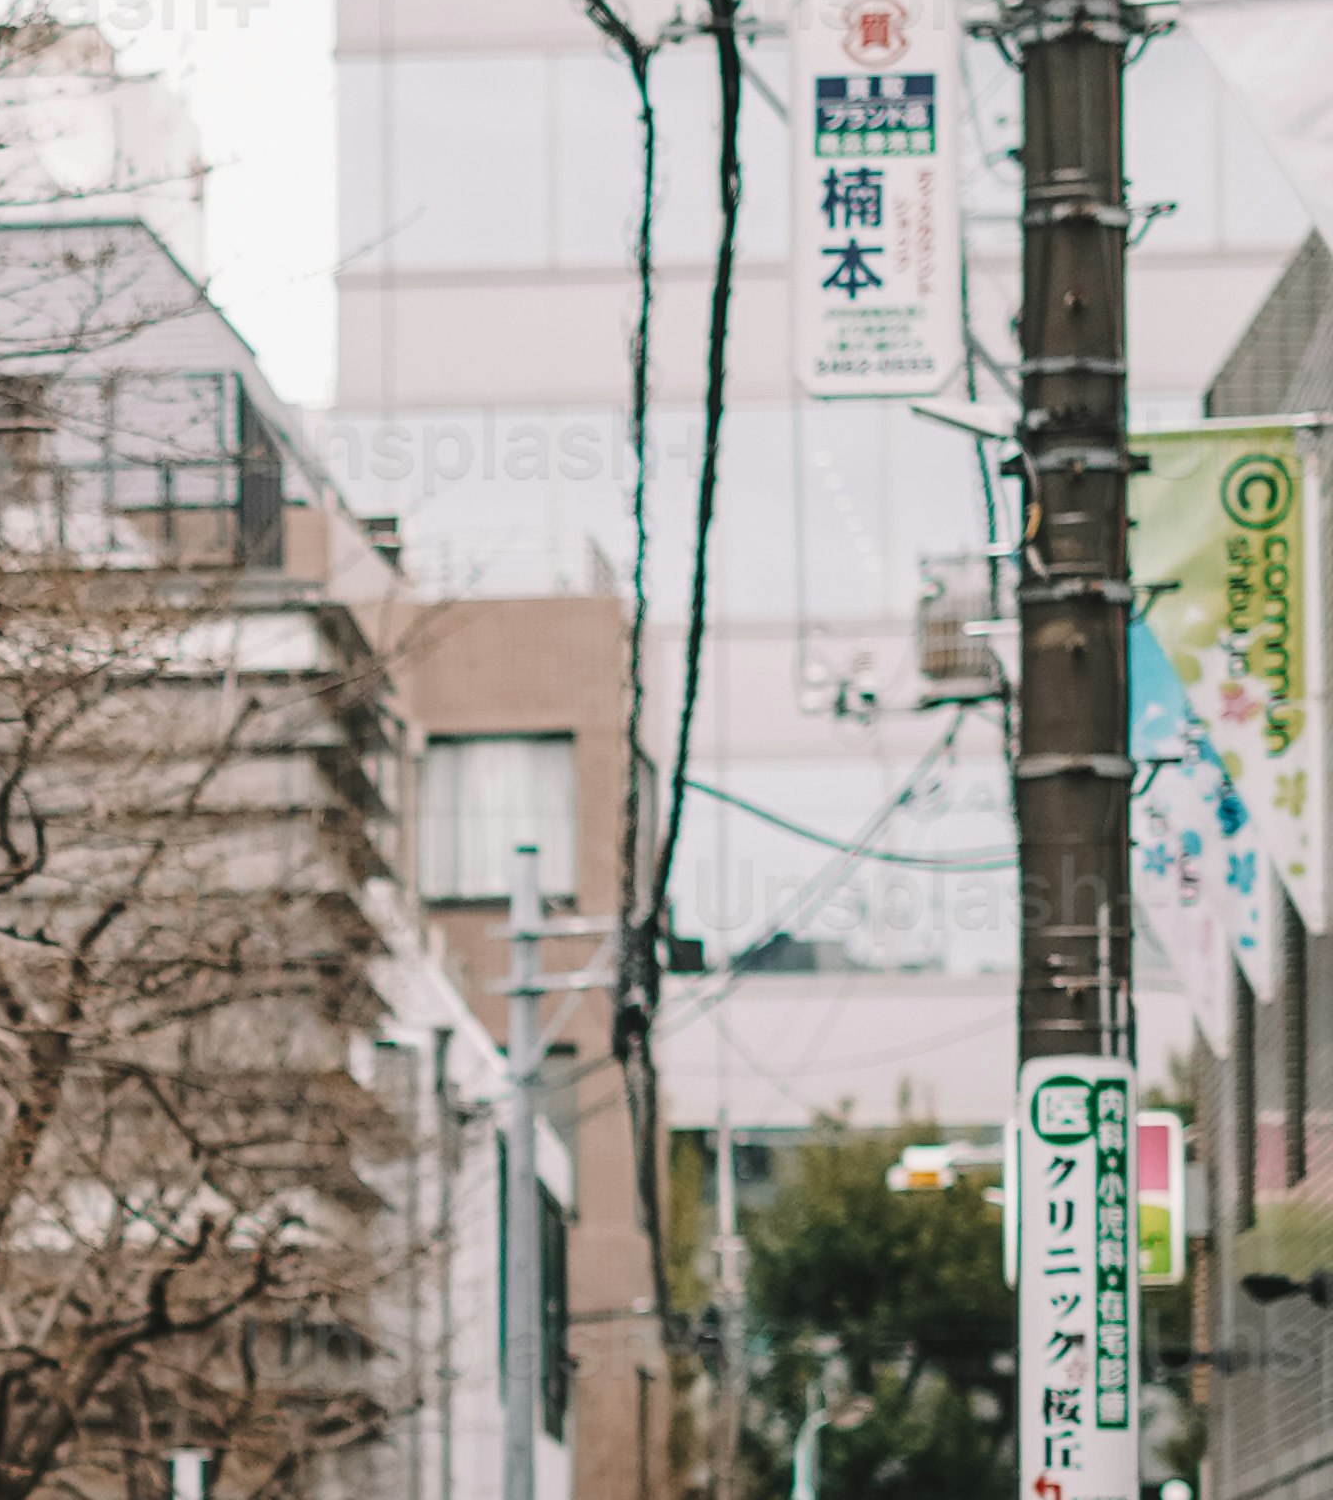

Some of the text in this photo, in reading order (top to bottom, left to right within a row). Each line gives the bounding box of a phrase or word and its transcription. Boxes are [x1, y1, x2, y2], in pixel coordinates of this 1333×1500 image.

[821, 166, 885, 300] 楠本
[1263, 535, 1291, 757] commun
[1037, 1086, 1091, 1134] 医
